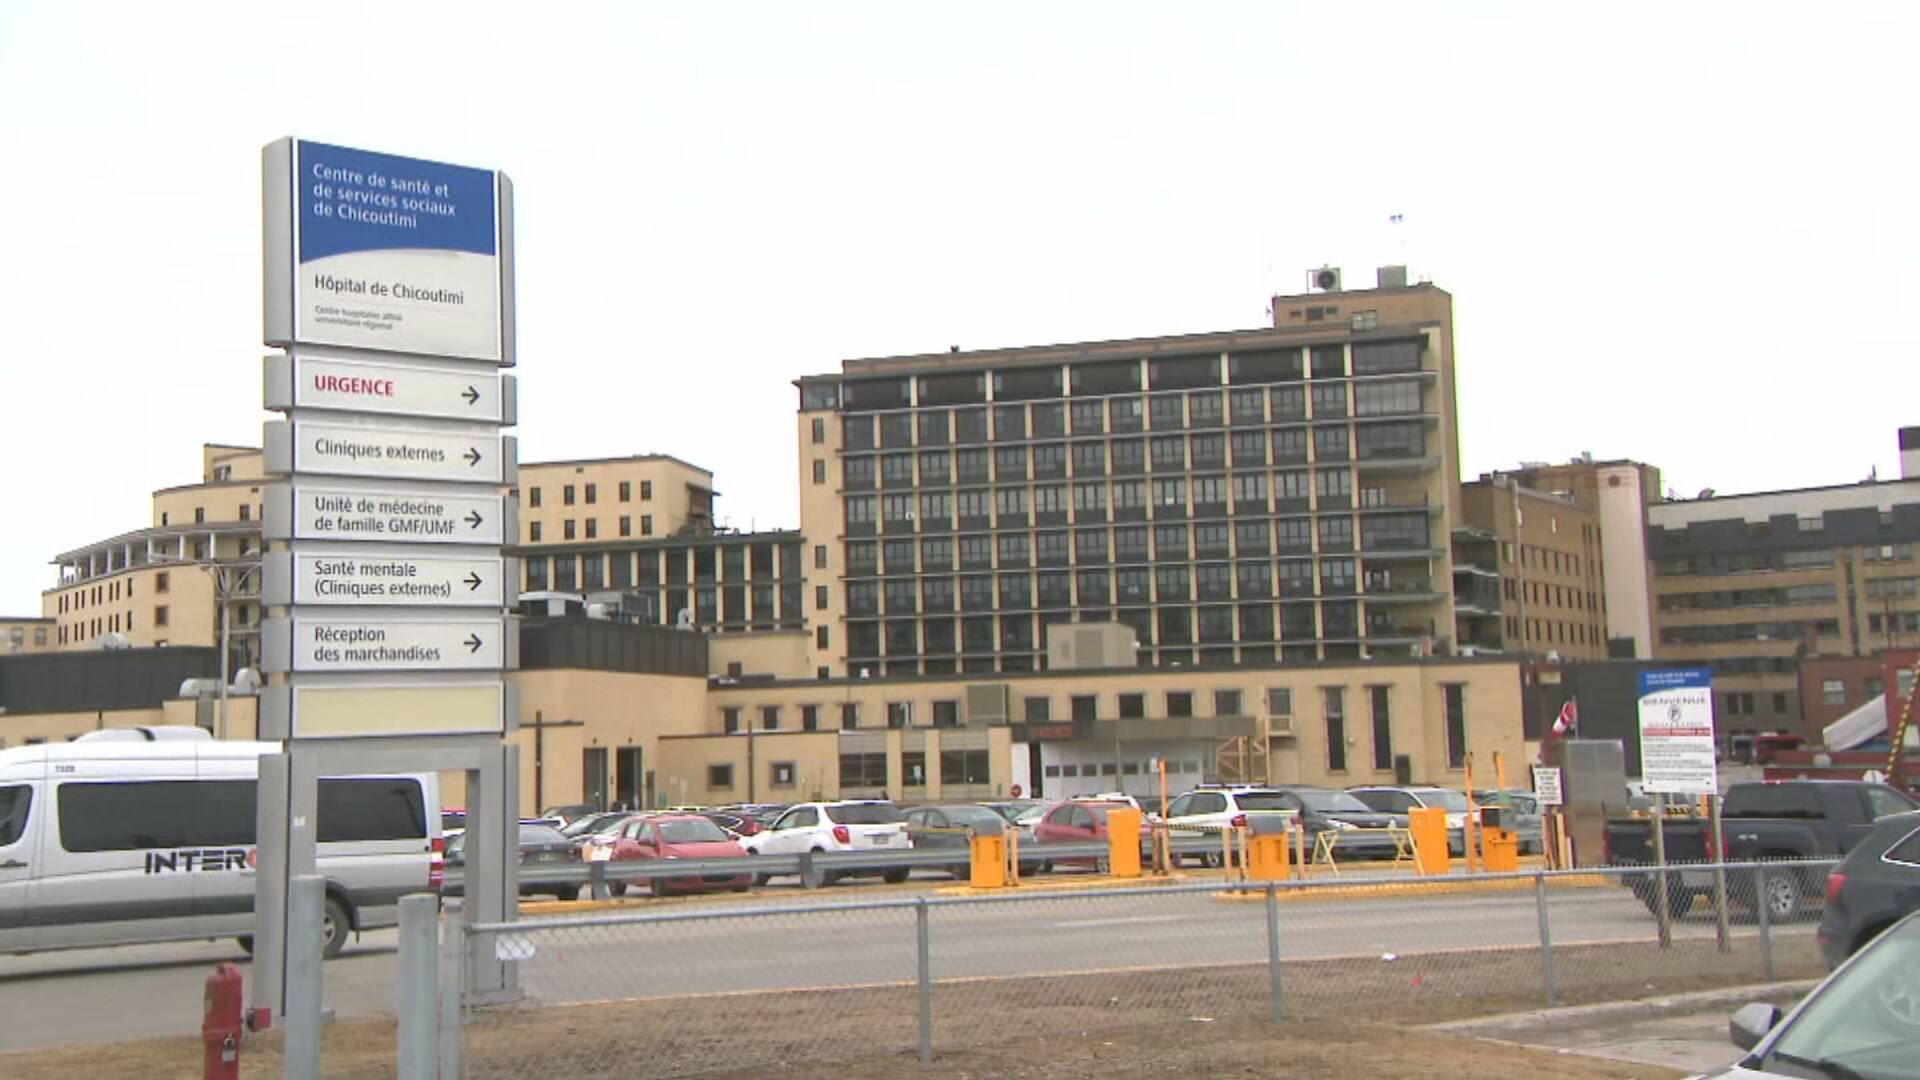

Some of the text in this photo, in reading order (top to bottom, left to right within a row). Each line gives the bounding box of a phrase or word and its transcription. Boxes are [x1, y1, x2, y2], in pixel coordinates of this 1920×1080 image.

[313, 163, 449, 198] Centre de santé et
[313, 183, 456, 217] de services sociaux
[313, 201, 418, 229] de Chicoutimi
[314, 274, 464, 305] Hôpital de Chicoutimi
[314, 375, 394, 396] URGENCE
[315, 438, 445, 462] Cliniques externes
[315, 497, 444, 516] Unité de médecine
[315, 516, 456, 535] de famille GMF/UMF
[315, 560, 417, 577] Santé mentale
[315, 580, 451, 598] (Cliniques externes)
[315, 626, 385, 644] Réception
[314, 646, 440, 661] des marchandises
